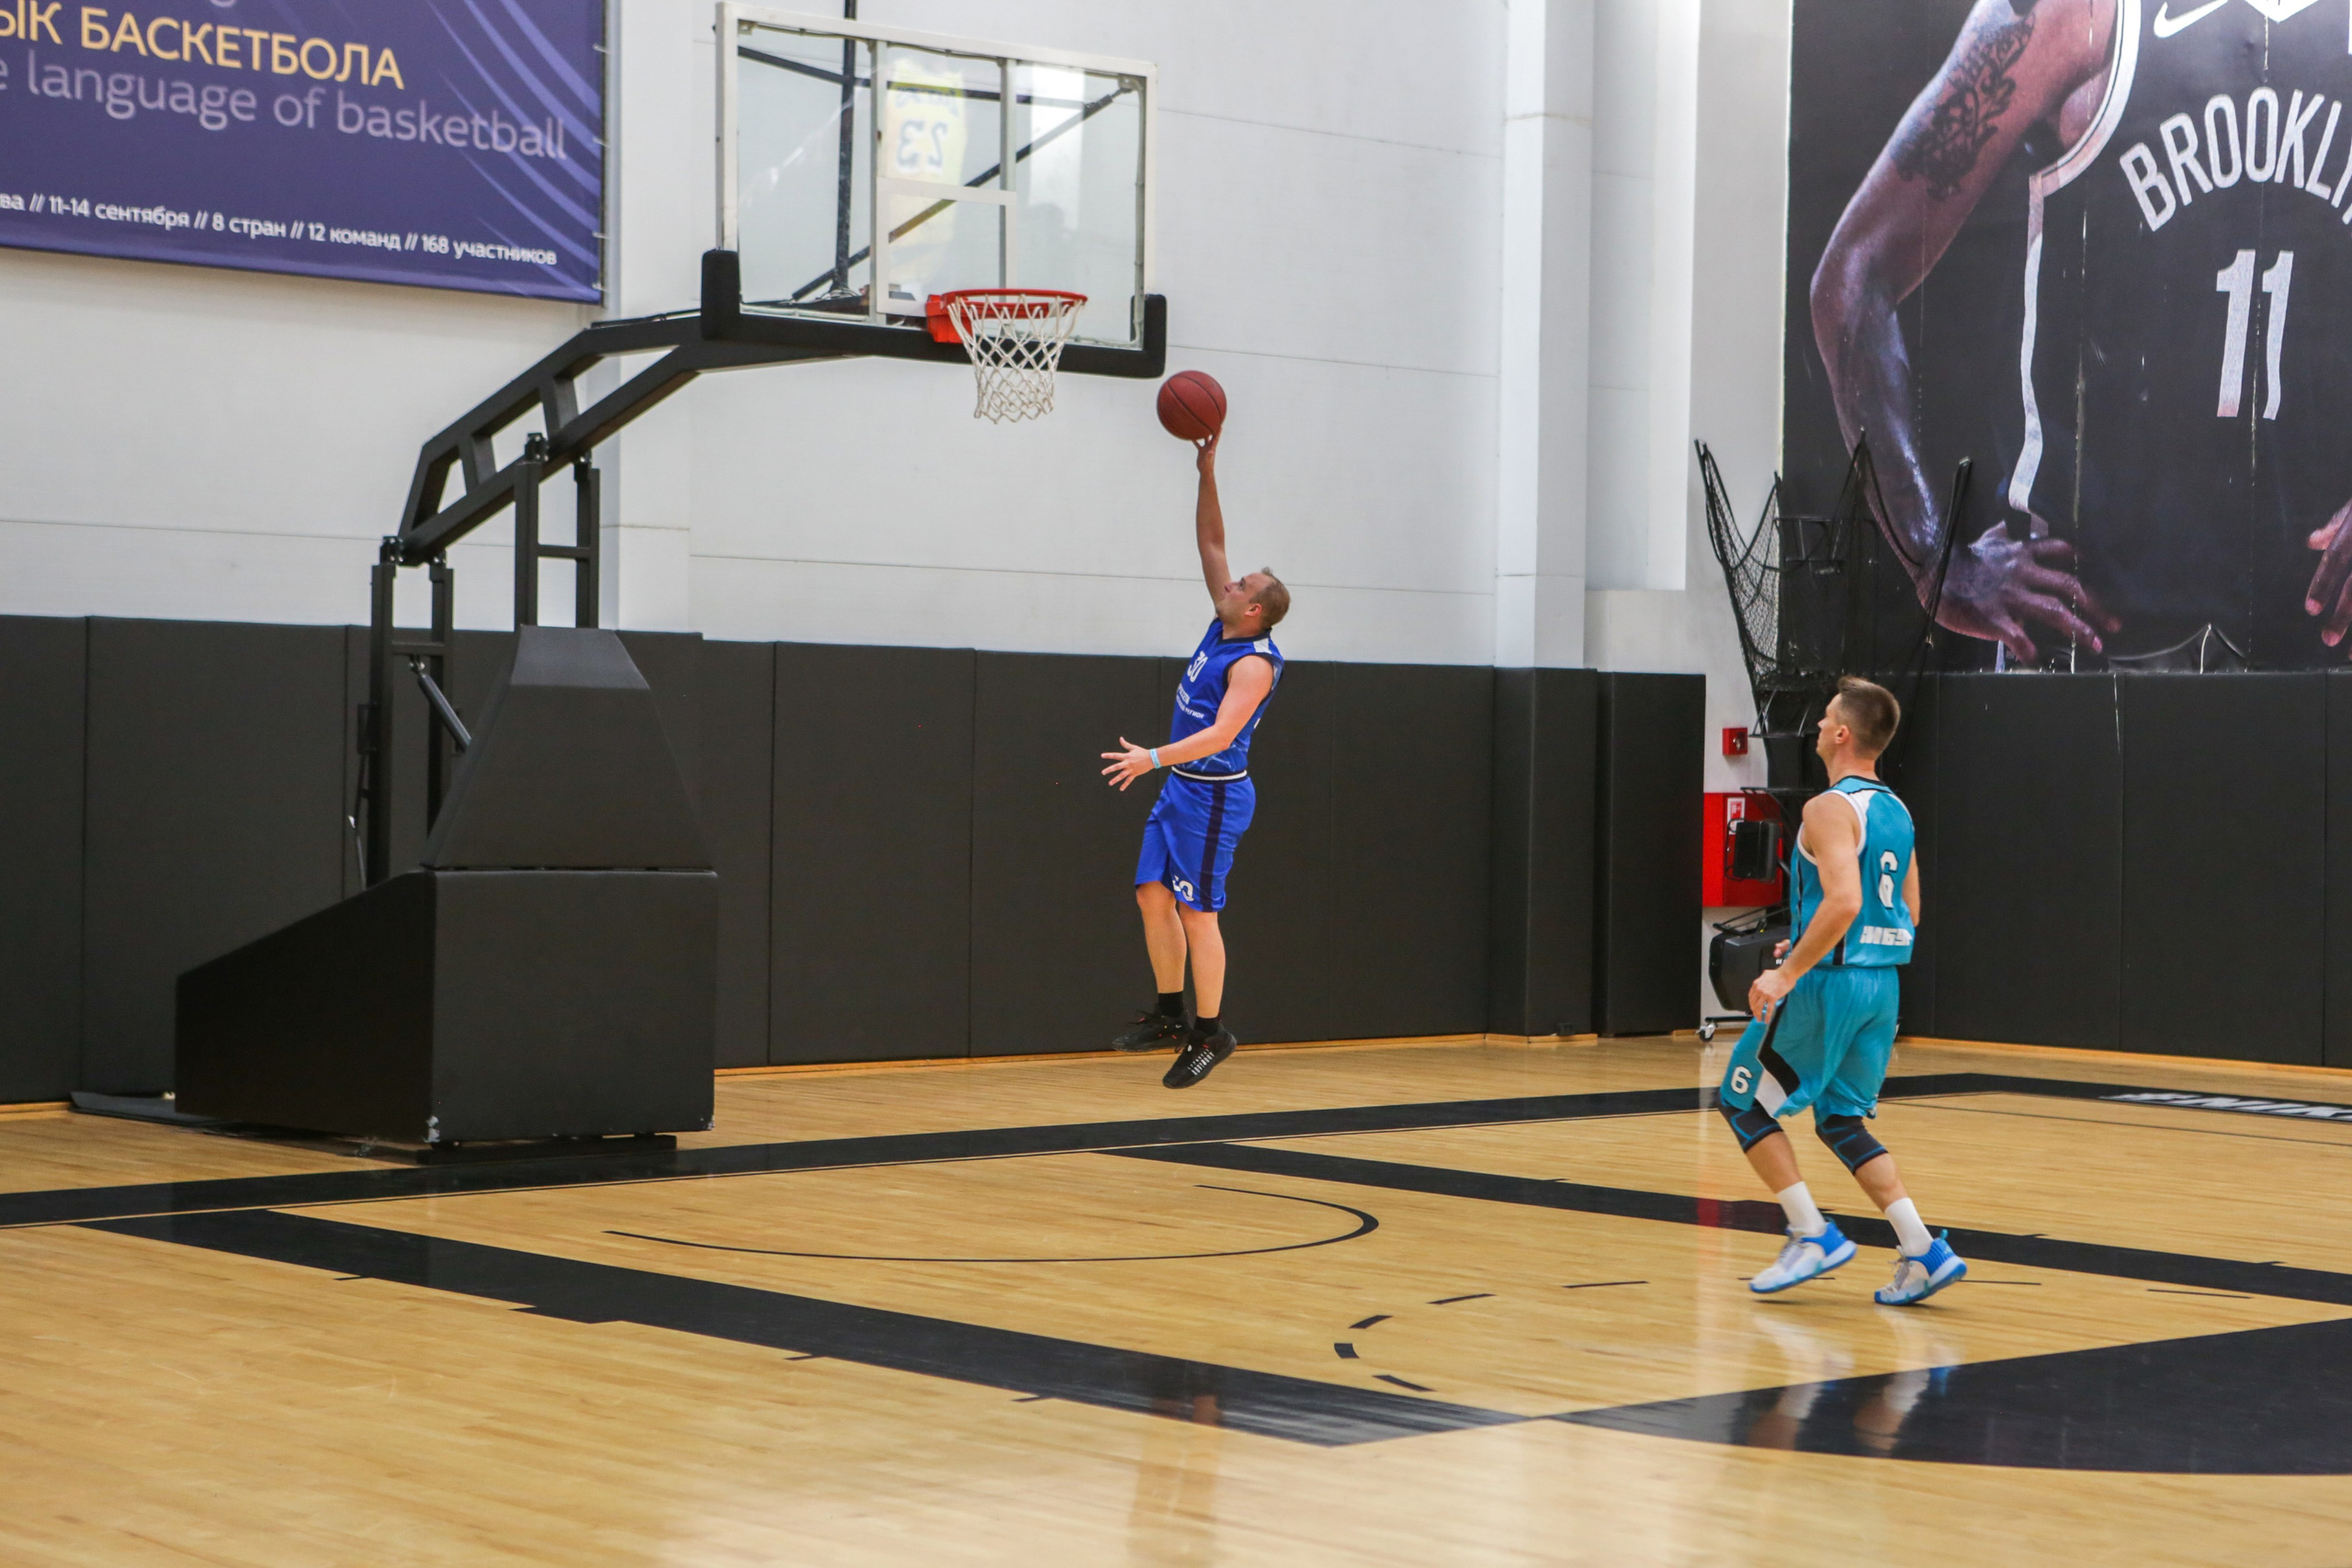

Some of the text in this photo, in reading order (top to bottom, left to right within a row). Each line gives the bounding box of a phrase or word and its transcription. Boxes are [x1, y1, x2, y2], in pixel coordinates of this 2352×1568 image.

[81, 6, 404, 89] БАСКЕТБОЛА
[28, 49, 256, 130] language
[274, 88, 322, 127] of
[336, 89, 568, 159] basketball
[2120, 86, 2352, 231] BROOKL
[49, 196, 90, 218] 11-14
[95, 203, 190, 231] сентября
[212, 212, 224, 231] 8
[229, 217, 287, 239] стран
[308, 222, 325, 242] 12
[330, 228, 401, 252] команд
[422, 234, 449, 254] 168
[453, 240, 558, 265] участников
[2216, 249, 2294, 420] 11
[1878, 849, 1899, 910] 6
[1731, 1066, 1753, 1095] 6
